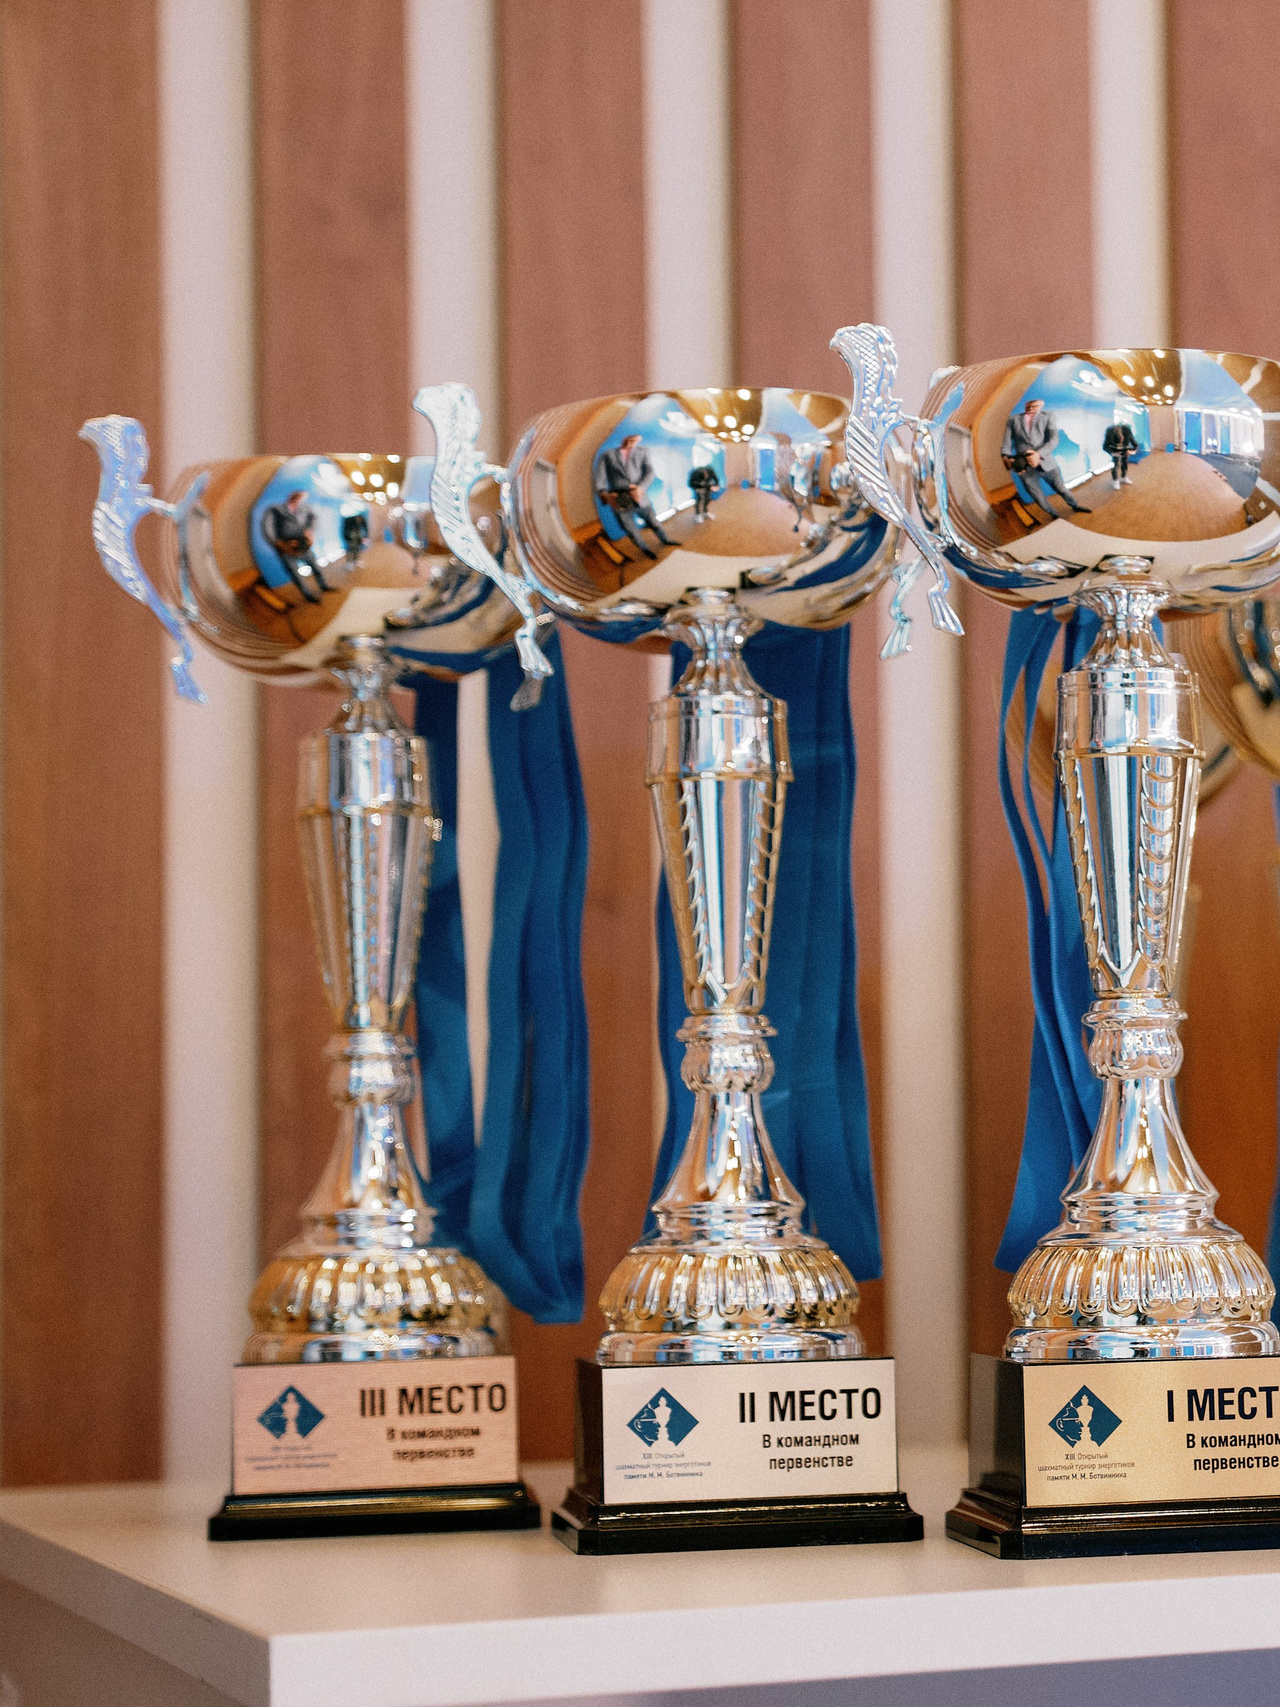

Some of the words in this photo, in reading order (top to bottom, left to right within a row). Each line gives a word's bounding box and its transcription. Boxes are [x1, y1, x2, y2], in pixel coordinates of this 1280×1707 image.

[398, 1383, 507, 1416] МЕСТО
[738, 1391, 756, 1424] II
[768, 1387, 882, 1423] МЕСТО
[401, 1426, 482, 1442] командном
[762, 1434, 772, 1449] В
[776, 1432, 860, 1450] командном
[1186, 1433, 1196, 1449] В
[769, 1453, 854, 1473] первенстве
[1077, 1451, 1109, 1461] Открытый
[1193, 1454, 1280, 1474] первенстве
[1037, 1462, 1074, 1472] шахматный
[1075, 1463, 1097, 1472] турнир
[1097, 1461, 1136, 1470] энергетиков
[1089, 1471, 1127, 1480] Ботвинника
